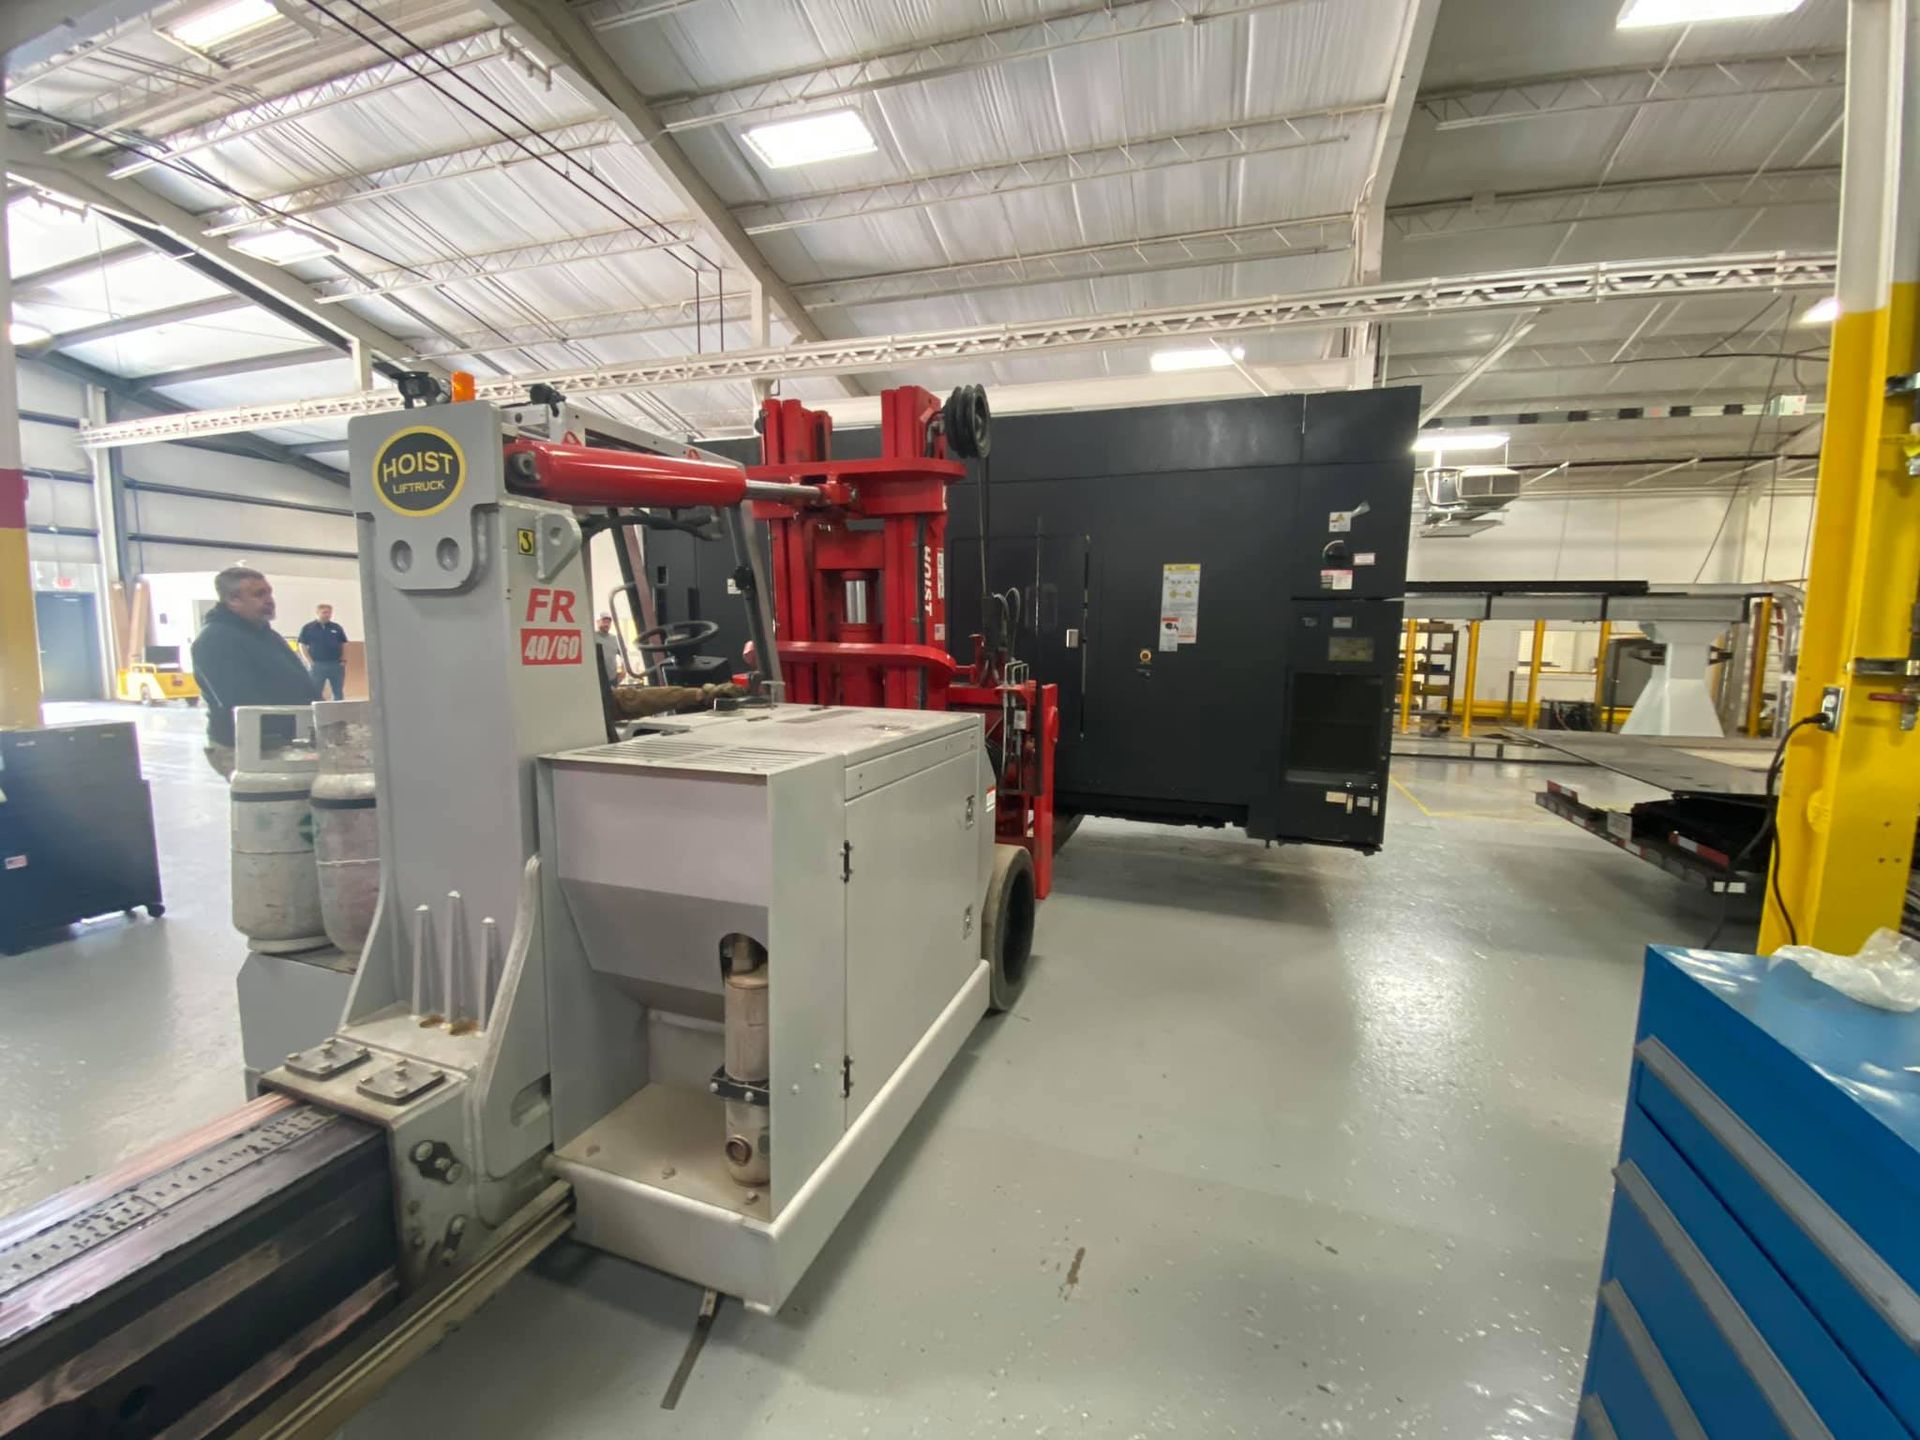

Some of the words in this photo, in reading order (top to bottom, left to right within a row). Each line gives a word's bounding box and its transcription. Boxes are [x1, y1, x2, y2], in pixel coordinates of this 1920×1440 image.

[382, 451, 453, 483] HOIST
[392, 480, 446, 495] LIFTRUCK
[526, 588, 576, 623] FR
[524, 635, 580, 660] 40/60
